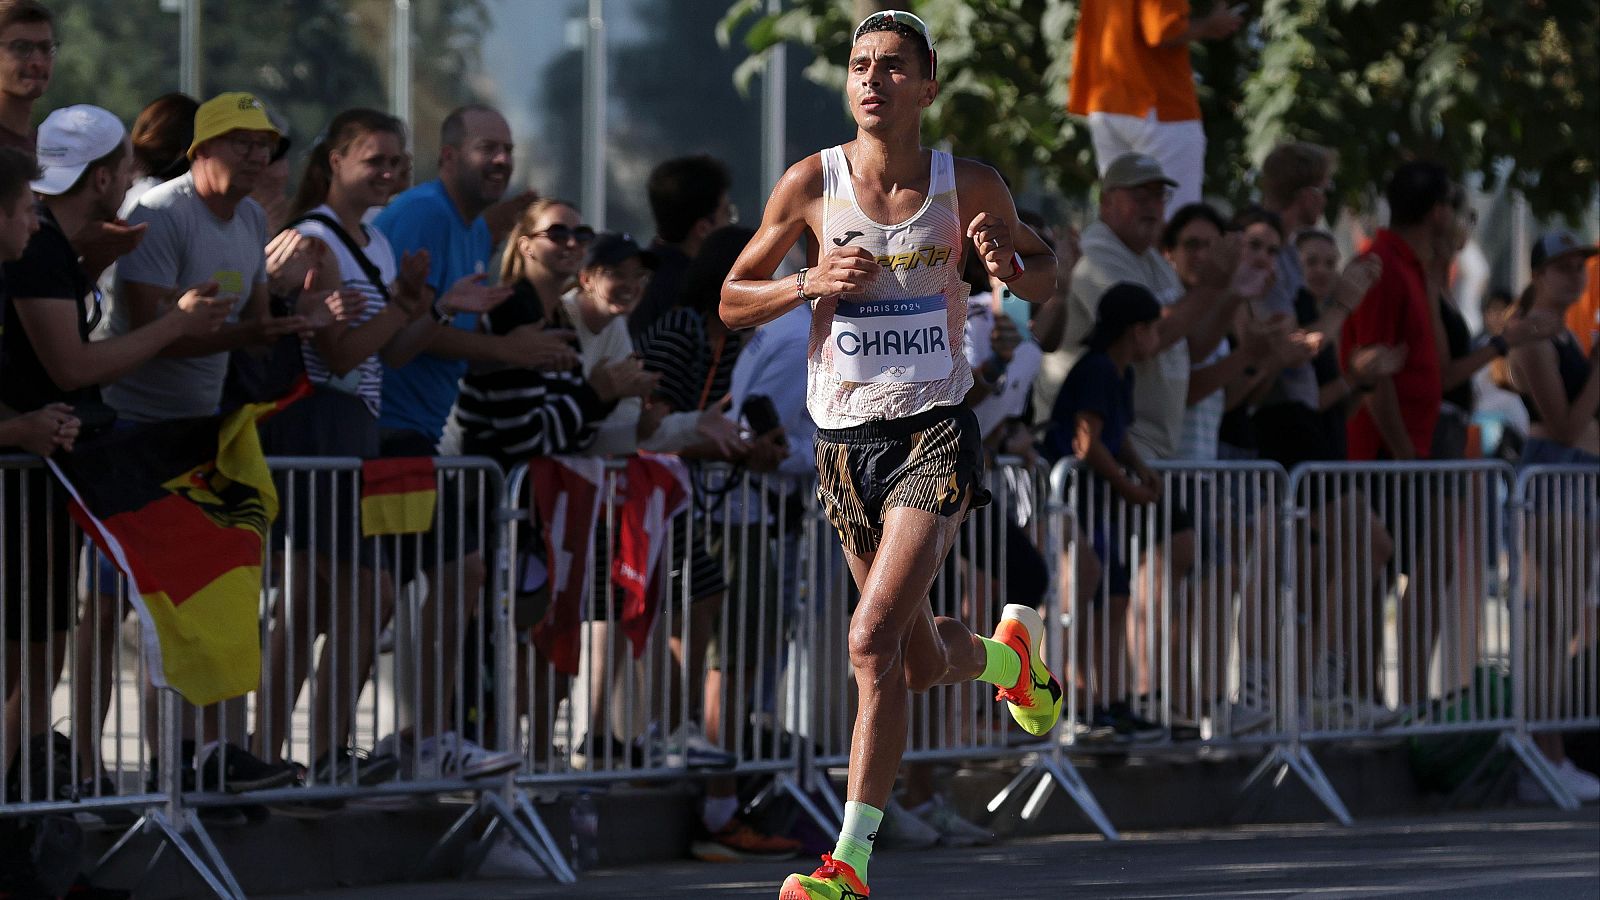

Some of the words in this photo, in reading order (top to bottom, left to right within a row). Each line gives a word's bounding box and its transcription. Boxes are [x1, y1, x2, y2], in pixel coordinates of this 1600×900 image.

[860, 305, 890, 314] PARIS
[894, 303, 921, 312] 2024
[836, 326, 946, 357] CHAKIR
